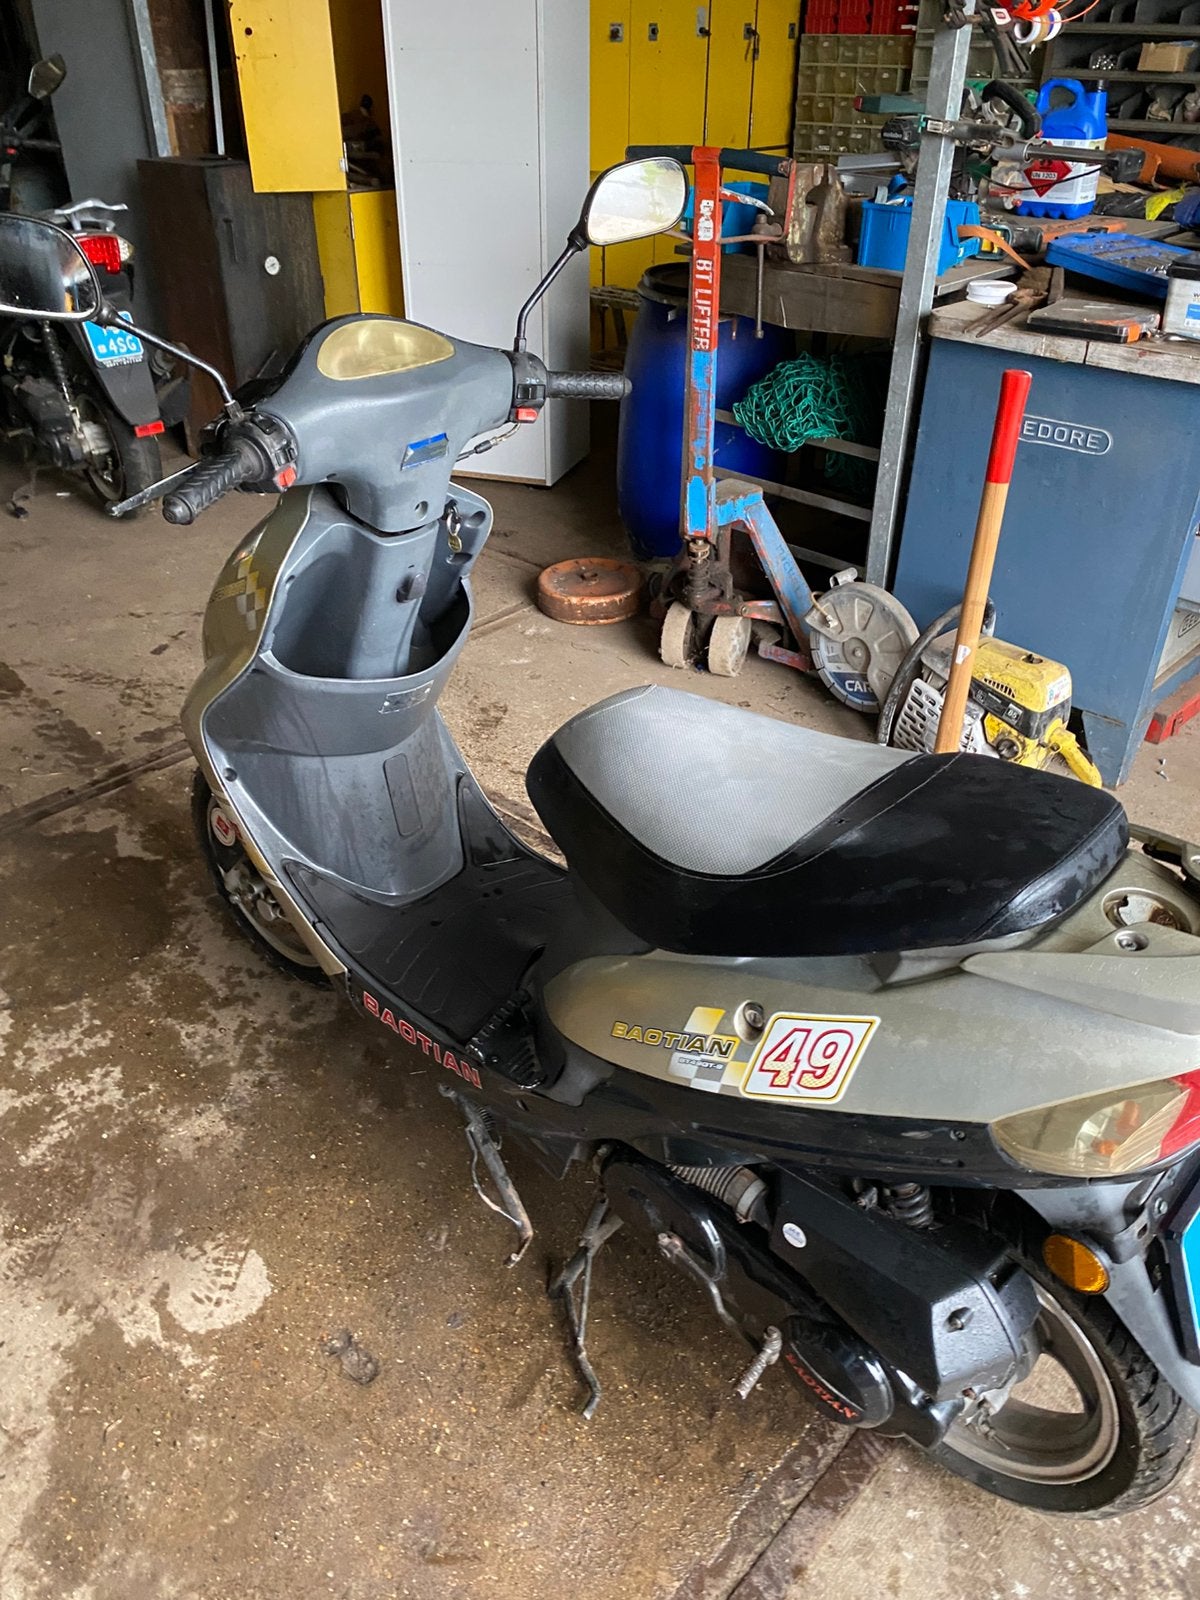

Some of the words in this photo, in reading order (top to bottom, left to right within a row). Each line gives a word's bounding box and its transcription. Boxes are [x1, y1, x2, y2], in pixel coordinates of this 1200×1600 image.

[695, 259, 713, 284] BT
[694, 288, 712, 350] LIFTER
[109, 336, 137, 354] 4SG
[1023, 420, 1102, 449] EDORE
[845, 680, 873, 693] CAR
[363, 990, 483, 1090] BAOTIAN
[611, 1021, 735, 1057] BAOTIAN
[758, 1027, 854, 1091] 49
